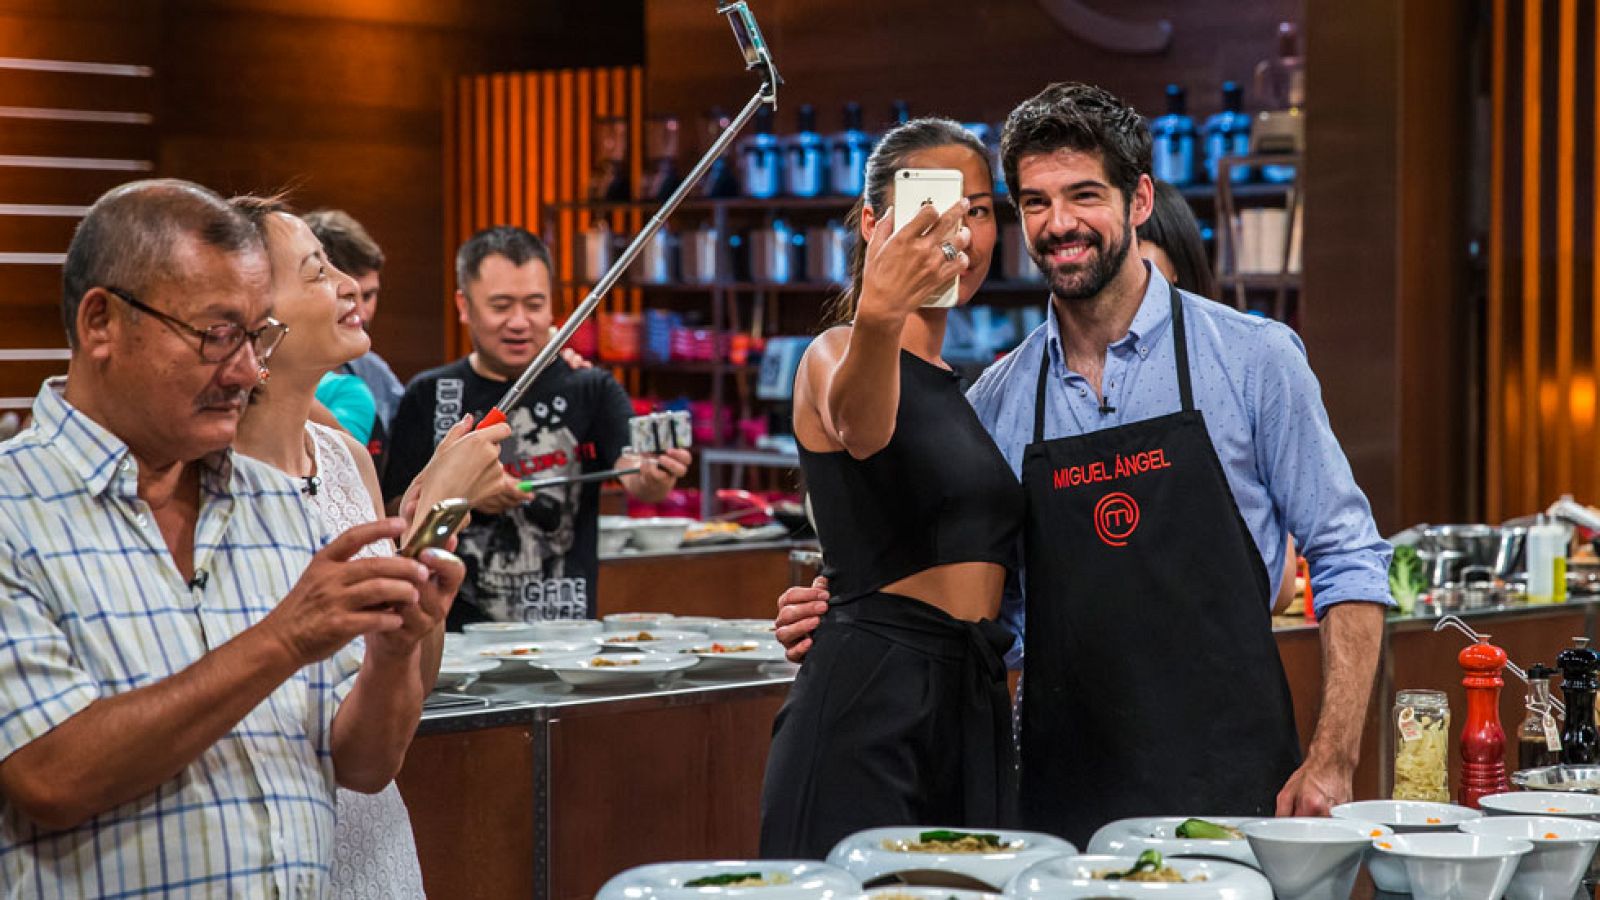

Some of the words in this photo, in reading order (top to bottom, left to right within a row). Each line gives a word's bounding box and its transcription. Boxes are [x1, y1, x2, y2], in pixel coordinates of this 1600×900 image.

[1054, 461, 1112, 489] MIGUEL
[1114, 448, 1171, 478] ÁNGEL
[522, 578, 586, 603] GAME
